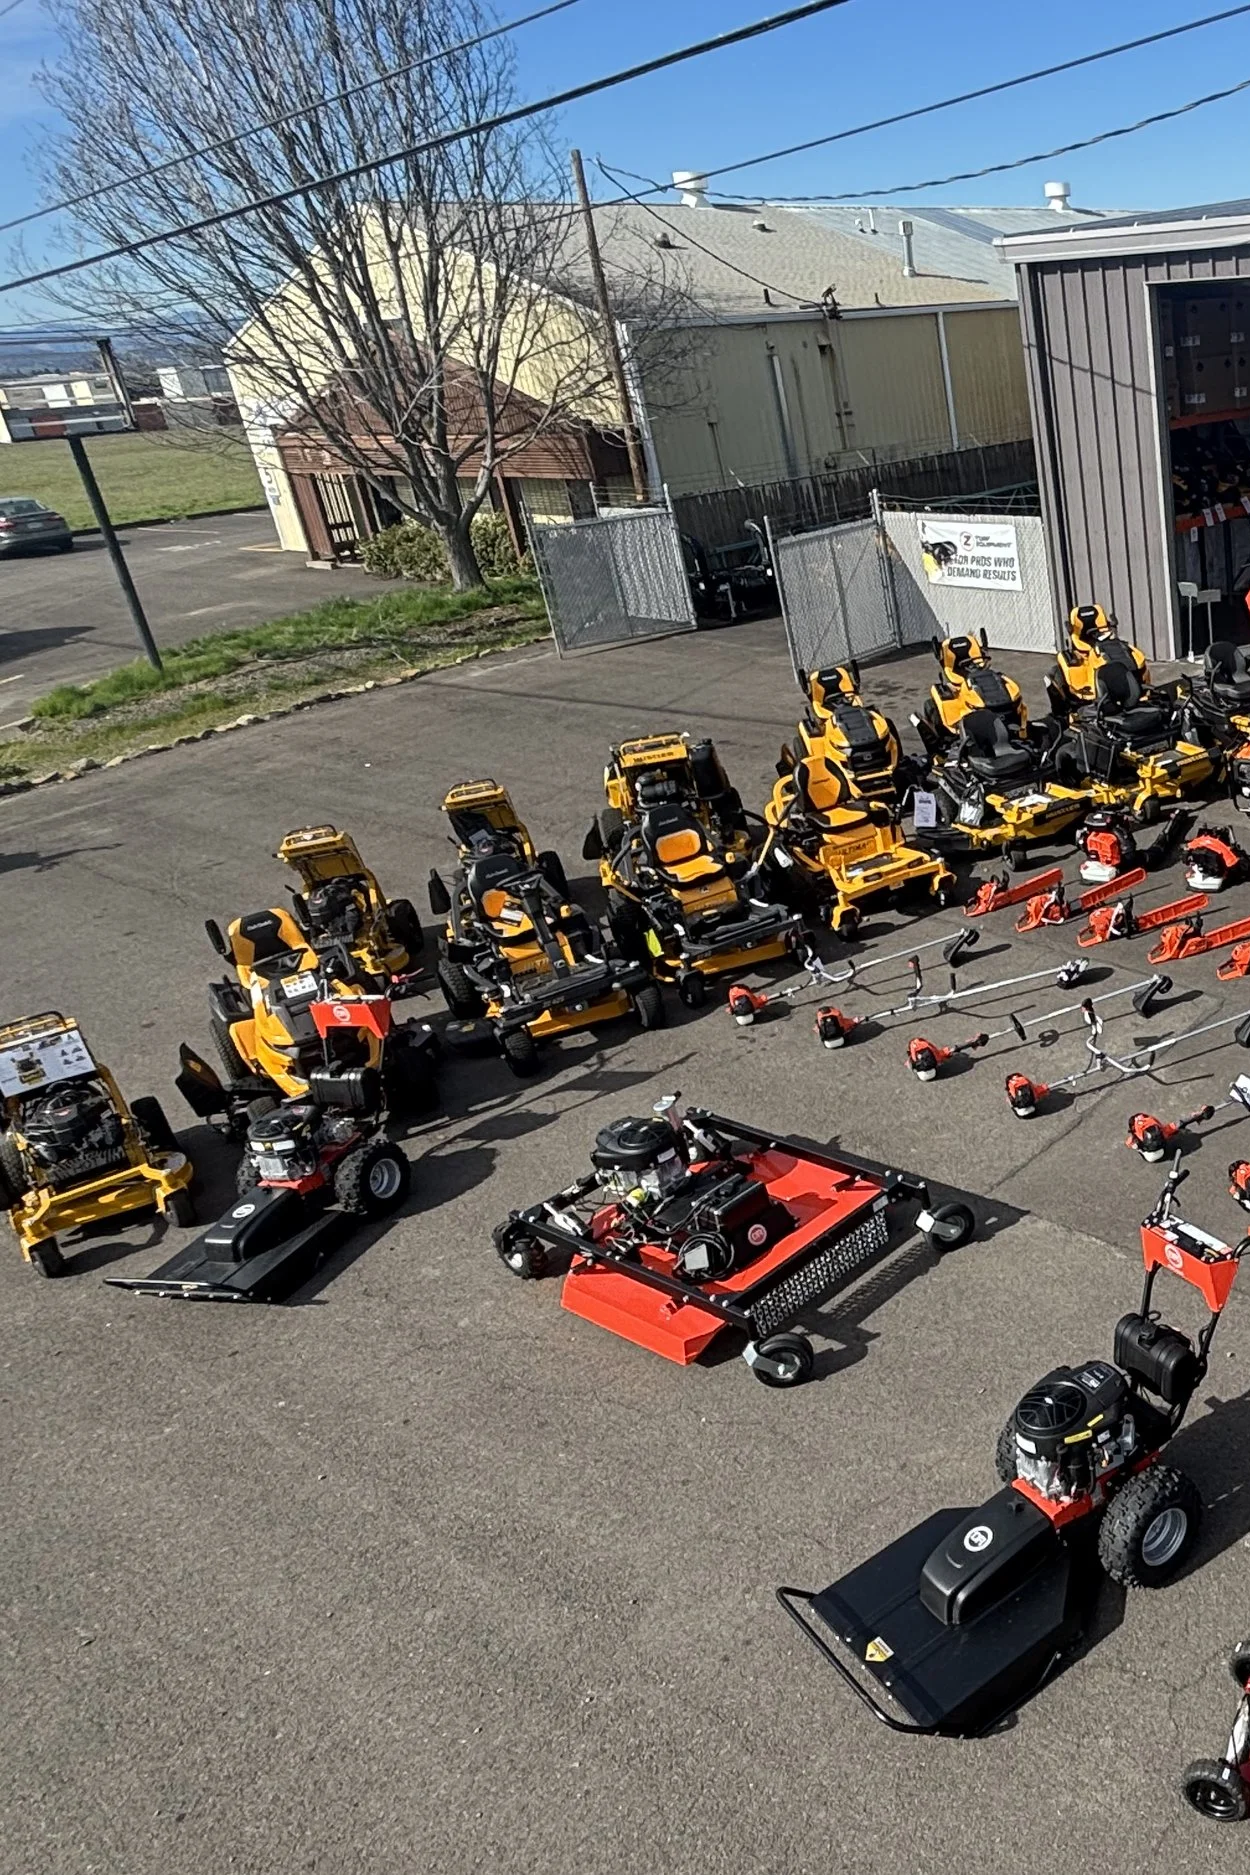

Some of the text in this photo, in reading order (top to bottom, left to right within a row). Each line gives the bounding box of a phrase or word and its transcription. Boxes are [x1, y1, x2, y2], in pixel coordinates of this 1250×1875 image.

[962, 535, 972, 547] Z
[970, 556, 992, 567] PROS
[994, 557, 1015, 568] WHO
[947, 567, 1017, 581] DEMAND RESULTS
